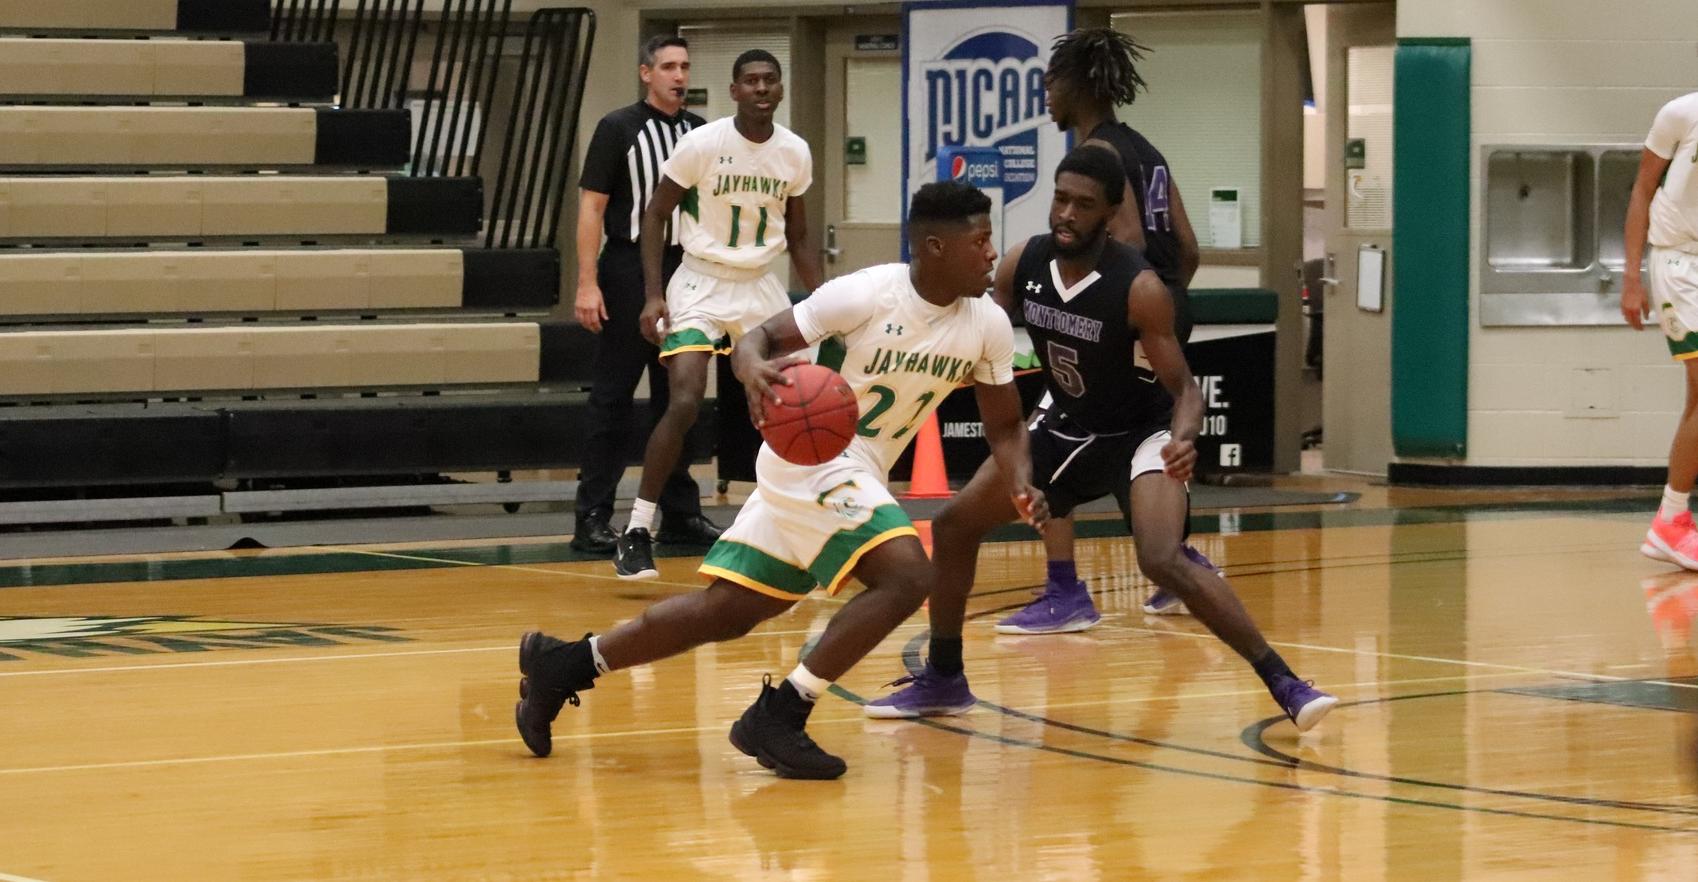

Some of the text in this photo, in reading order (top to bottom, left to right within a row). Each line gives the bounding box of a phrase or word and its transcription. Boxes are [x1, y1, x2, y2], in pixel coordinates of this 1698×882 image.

[967, 160, 999, 182] pepsi
[712, 174, 788, 202] JAYHAWKS
[727, 204, 768, 248] 11
[1047, 340, 1086, 398] 5
[942, 422, 985, 438] JAMEST
